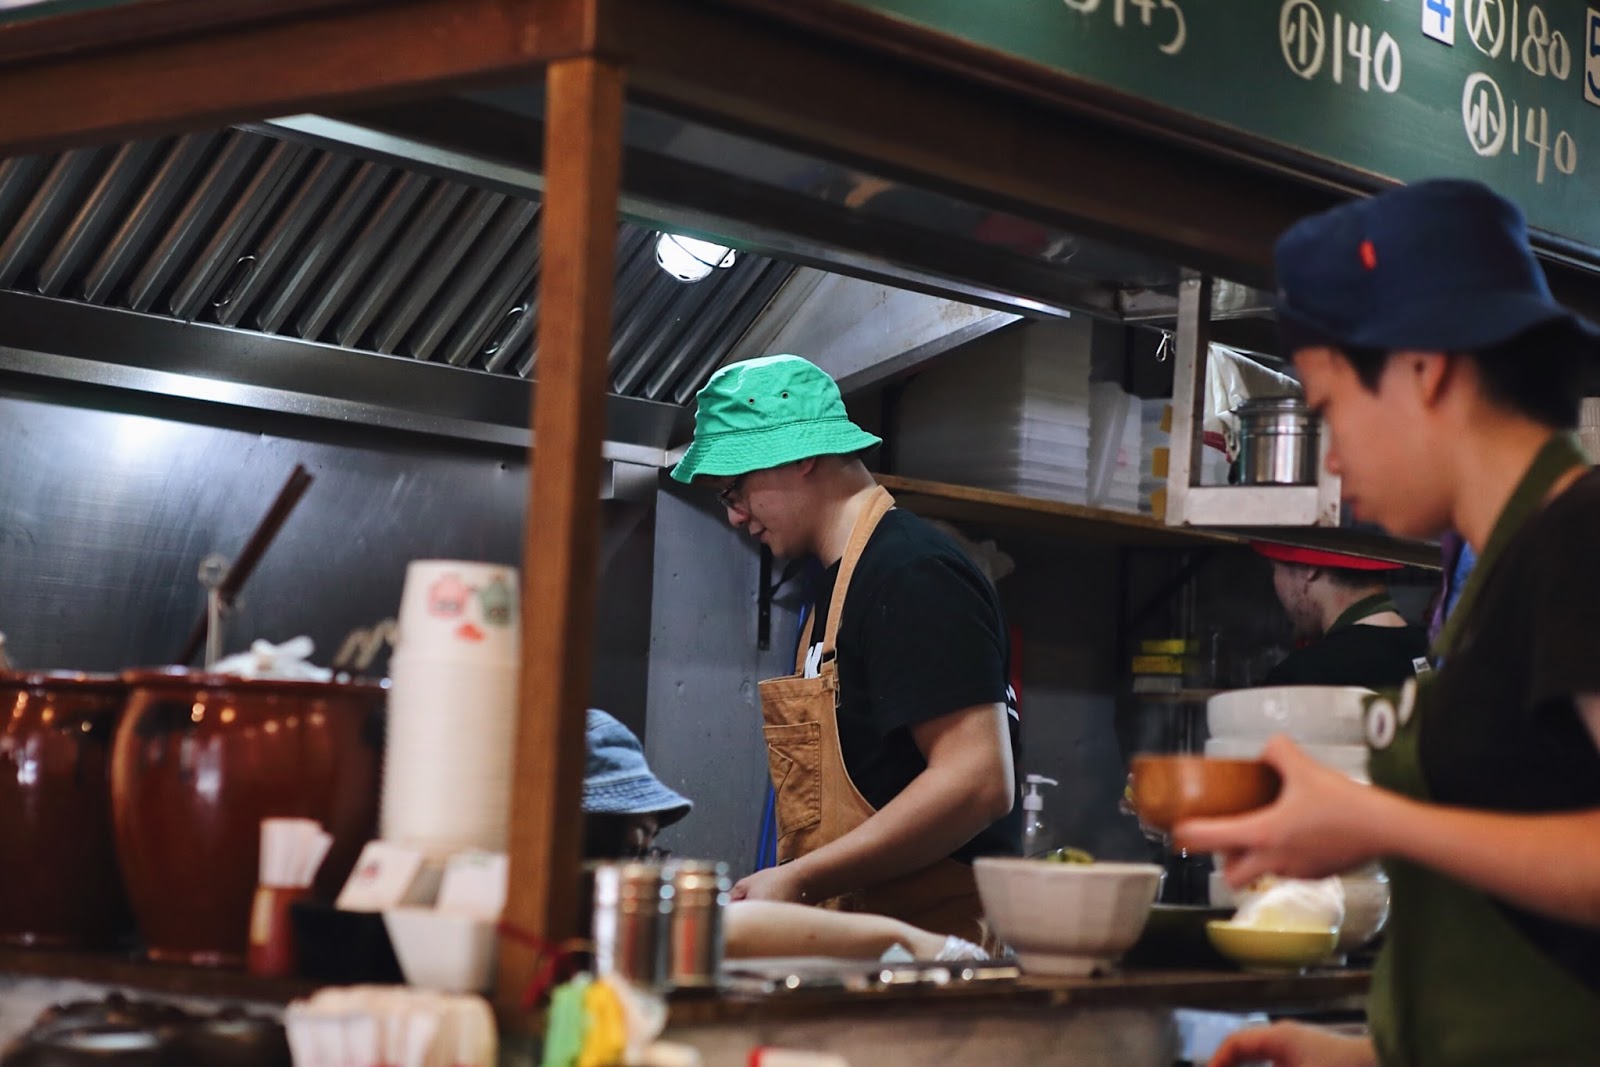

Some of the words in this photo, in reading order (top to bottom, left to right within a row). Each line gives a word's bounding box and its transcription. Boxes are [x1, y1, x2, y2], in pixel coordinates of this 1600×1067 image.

[1333, 12, 1402, 93] 140
[1511, 0, 1571, 81] 180
[1512, 99, 1577, 184] 140
